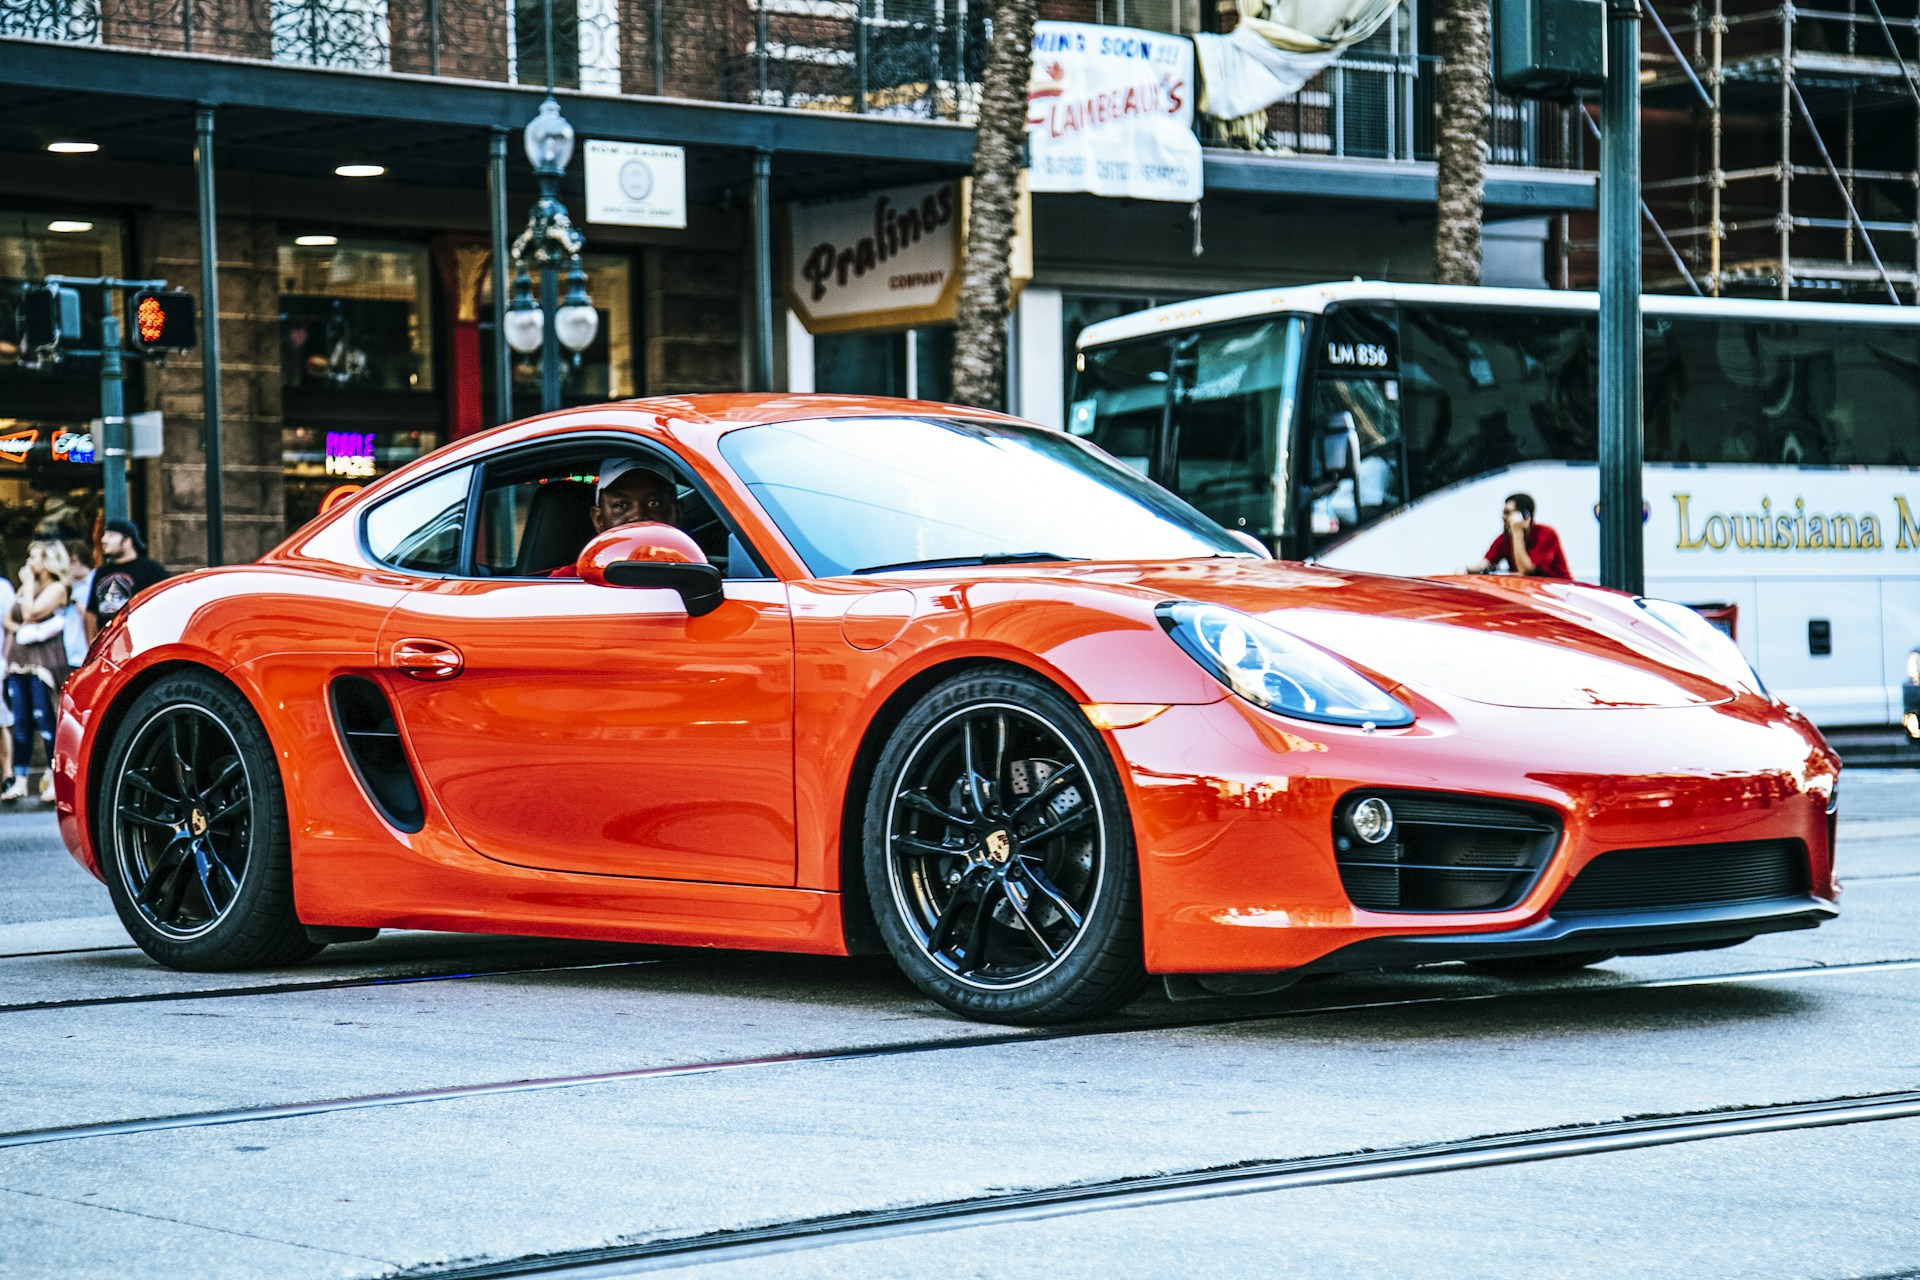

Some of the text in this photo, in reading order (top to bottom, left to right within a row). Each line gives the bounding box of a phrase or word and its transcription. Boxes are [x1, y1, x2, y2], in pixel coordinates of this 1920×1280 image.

[803, 185, 953, 302] Pralines
[888, 270, 945, 291] COMPANY
[1328, 342, 1388, 367] LM 856
[1673, 494, 1883, 550] Louisiana
[165, 683, 243, 736] GOODYEAR
